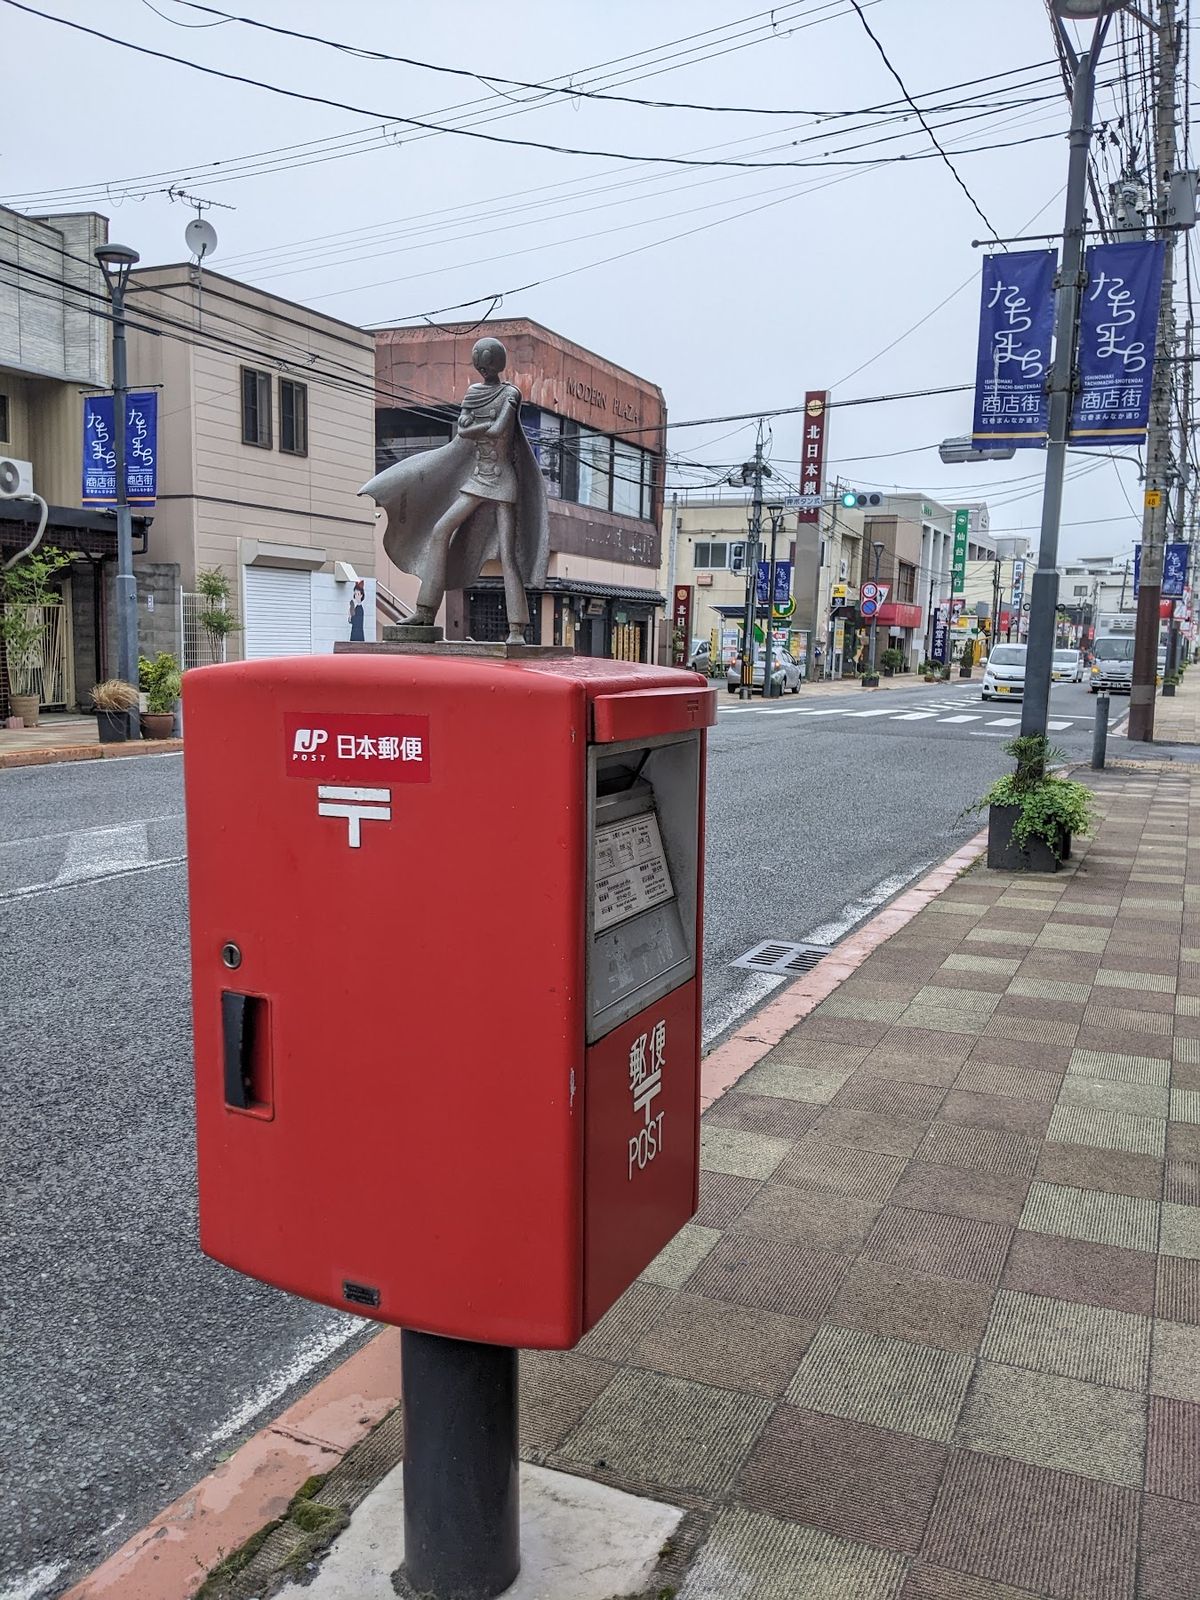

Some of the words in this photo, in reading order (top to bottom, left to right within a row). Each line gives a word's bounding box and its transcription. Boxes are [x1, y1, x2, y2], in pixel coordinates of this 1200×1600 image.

[987, 280, 1043, 379] たちまち
[1090, 272, 1147, 373] たちまち
[566, 377, 607, 410] MODERN
[613, 397, 639, 424] PLAZA
[982, 394, 1041, 413] 商店街
[1081, 388, 1142, 409] 商店街
[1081, 412, 1140, 421] 石巻まんなか通り
[87, 412, 117, 468] たちまち
[128, 408, 153, 466] たちまち
[86, 476, 116, 488] 商店街
[127, 474, 153, 486] 商店街
[786, 497, 821, 506] 押ボタン式
[954, 532, 965, 586] 仙台銀行
[865, 587, 875, 595] 30
[292, 753, 326, 762] POST
[337, 734, 423, 762] 日本郵便
[629, 1019, 666, 1091] 郵便
[628, 1111, 665, 1181] POST
